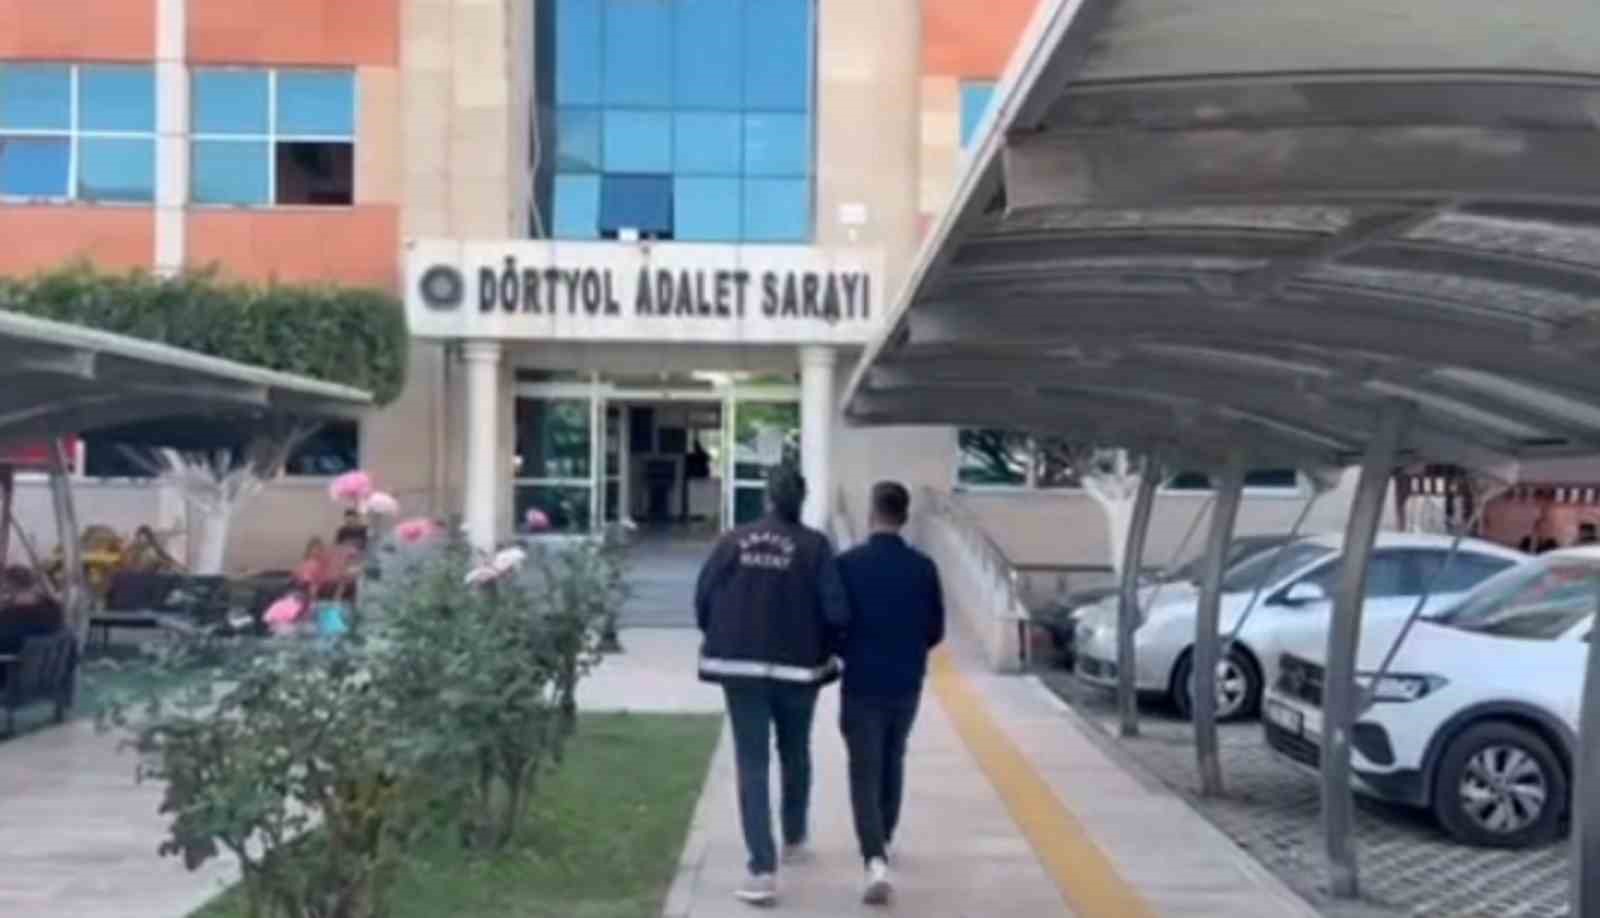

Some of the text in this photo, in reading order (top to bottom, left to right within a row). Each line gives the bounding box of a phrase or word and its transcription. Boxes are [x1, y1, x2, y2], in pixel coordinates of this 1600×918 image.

[478, 256, 870, 322] DÖRTYOL ADALET SARAYI
